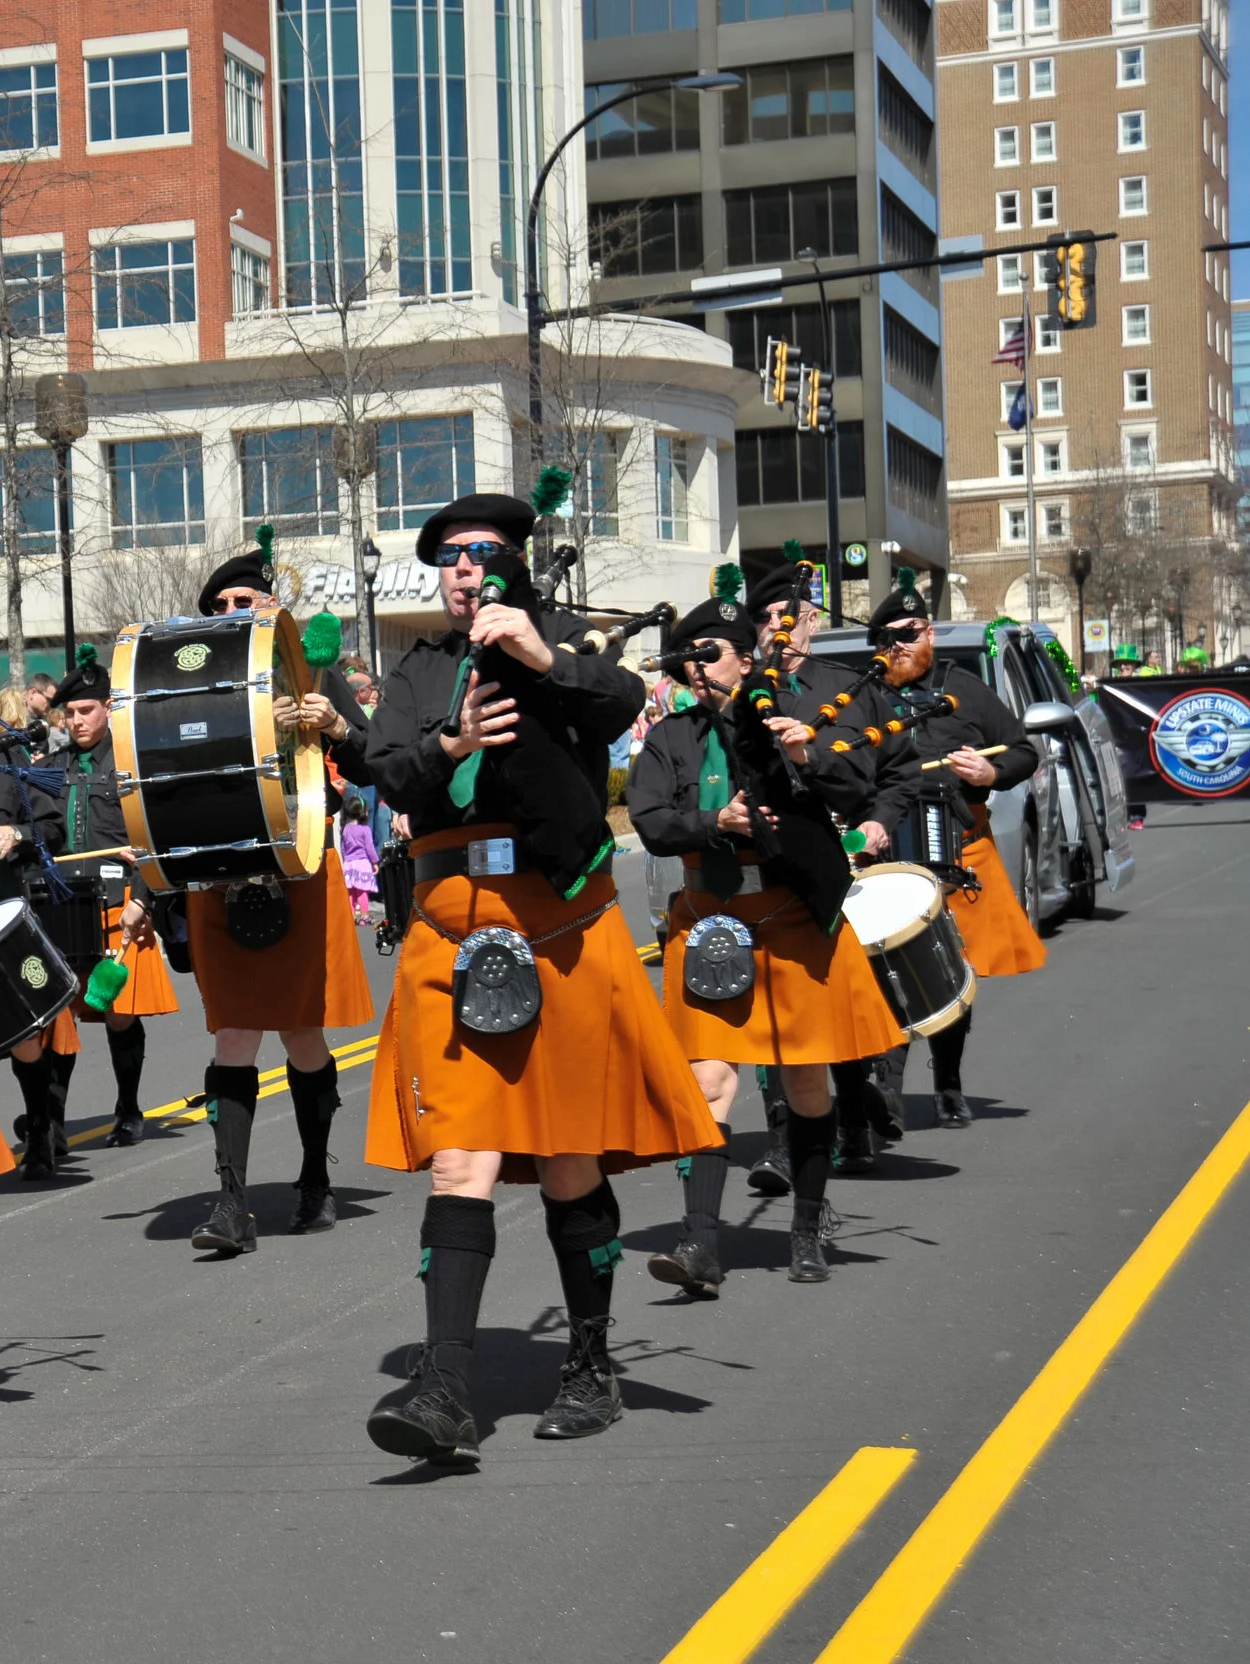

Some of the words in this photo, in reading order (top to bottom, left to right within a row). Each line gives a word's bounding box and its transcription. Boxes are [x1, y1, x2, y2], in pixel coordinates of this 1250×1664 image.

[1165, 697, 1215, 728] UPSTATE
[1177, 767, 1204, 785] SOUTH
[1203, 765, 1245, 785] CAROLINA
[926, 804, 942, 862] PREMIER
